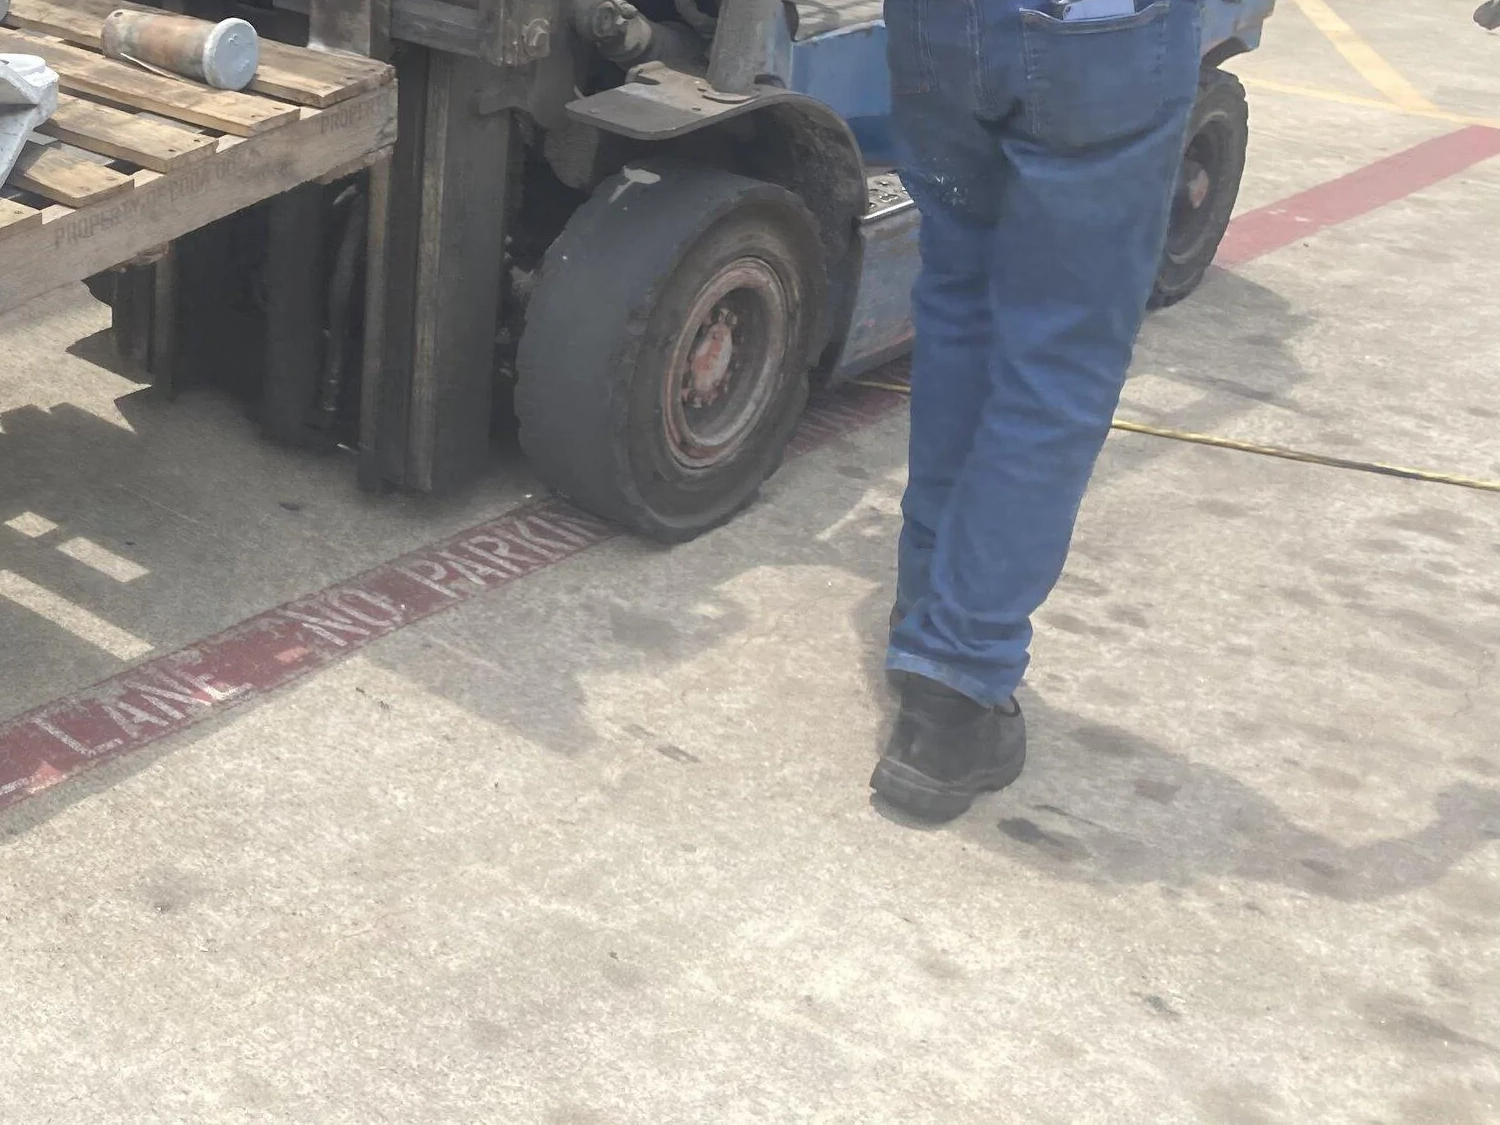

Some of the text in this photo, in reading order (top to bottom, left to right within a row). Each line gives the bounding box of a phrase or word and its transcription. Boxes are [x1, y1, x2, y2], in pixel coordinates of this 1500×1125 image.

[33, 655, 252, 756] LANE
[275, 587, 403, 647] NO
[396, 503, 608, 597] PARKIN
